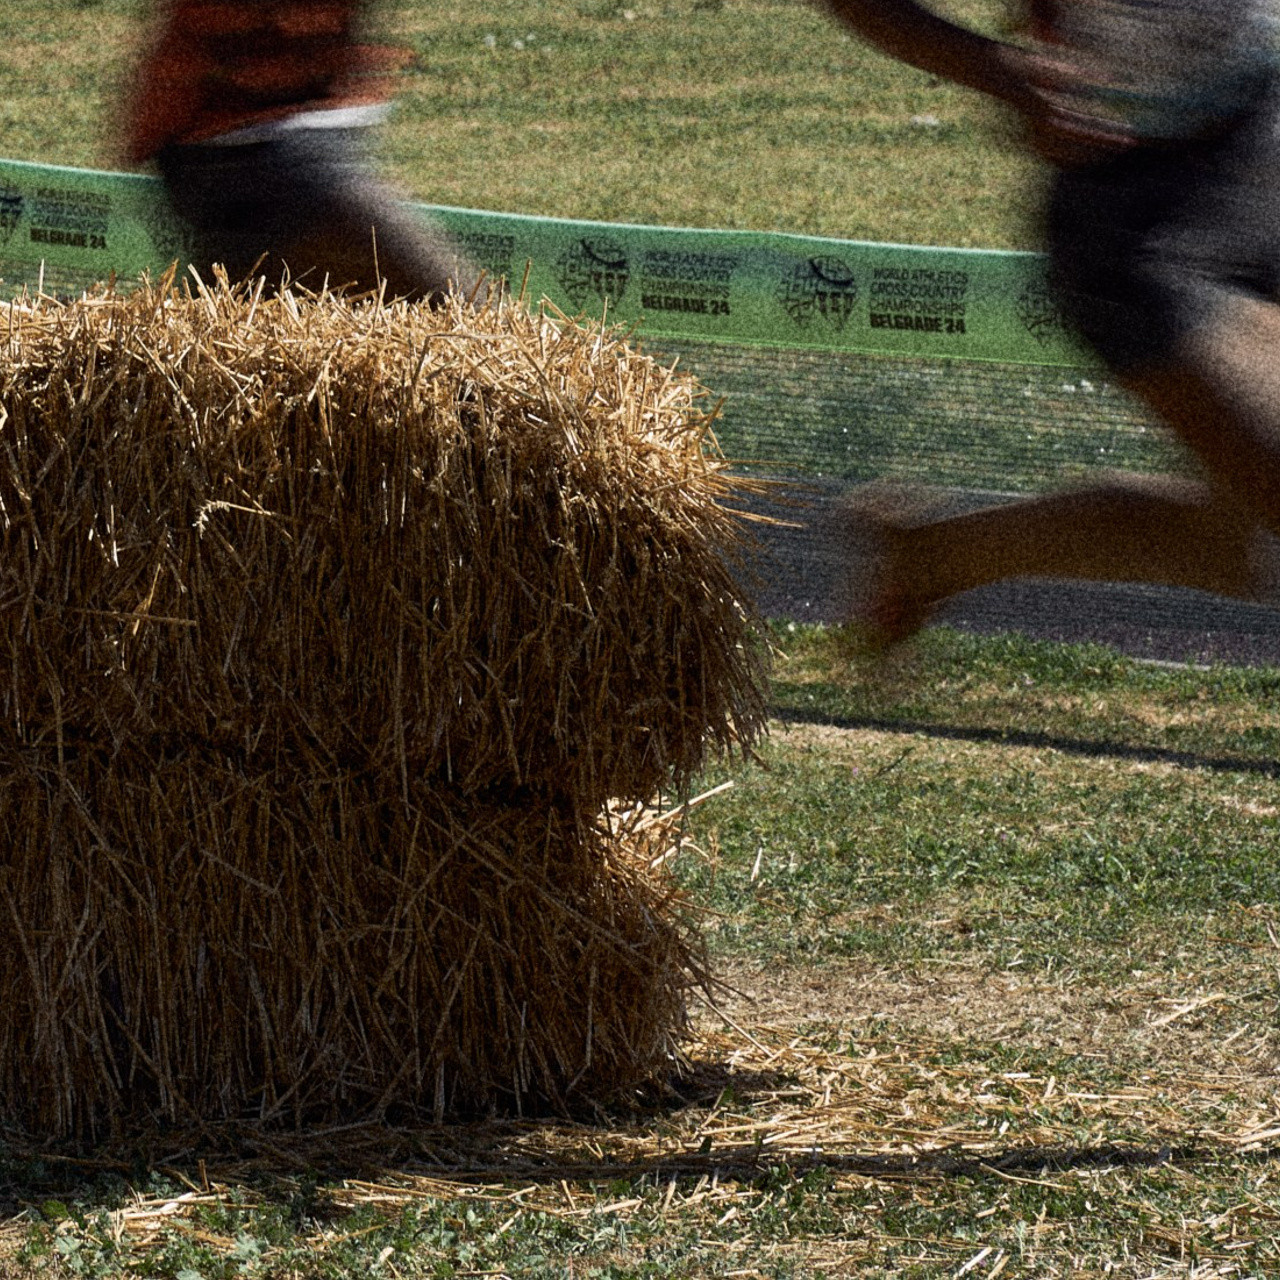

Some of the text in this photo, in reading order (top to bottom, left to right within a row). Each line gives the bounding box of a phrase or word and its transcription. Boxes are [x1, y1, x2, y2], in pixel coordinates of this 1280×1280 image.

[30, 228, 108, 250] BELGRADE 24
[873, 267, 969, 284] WORLD ATHLETICS
[870, 281, 967, 299] CROSS COUNTRY
[642, 294, 731, 316] BELGRADE 24
[870, 297, 966, 316] CHAMPIONSHIPS
[869, 312, 967, 334] BELGRADE 24
